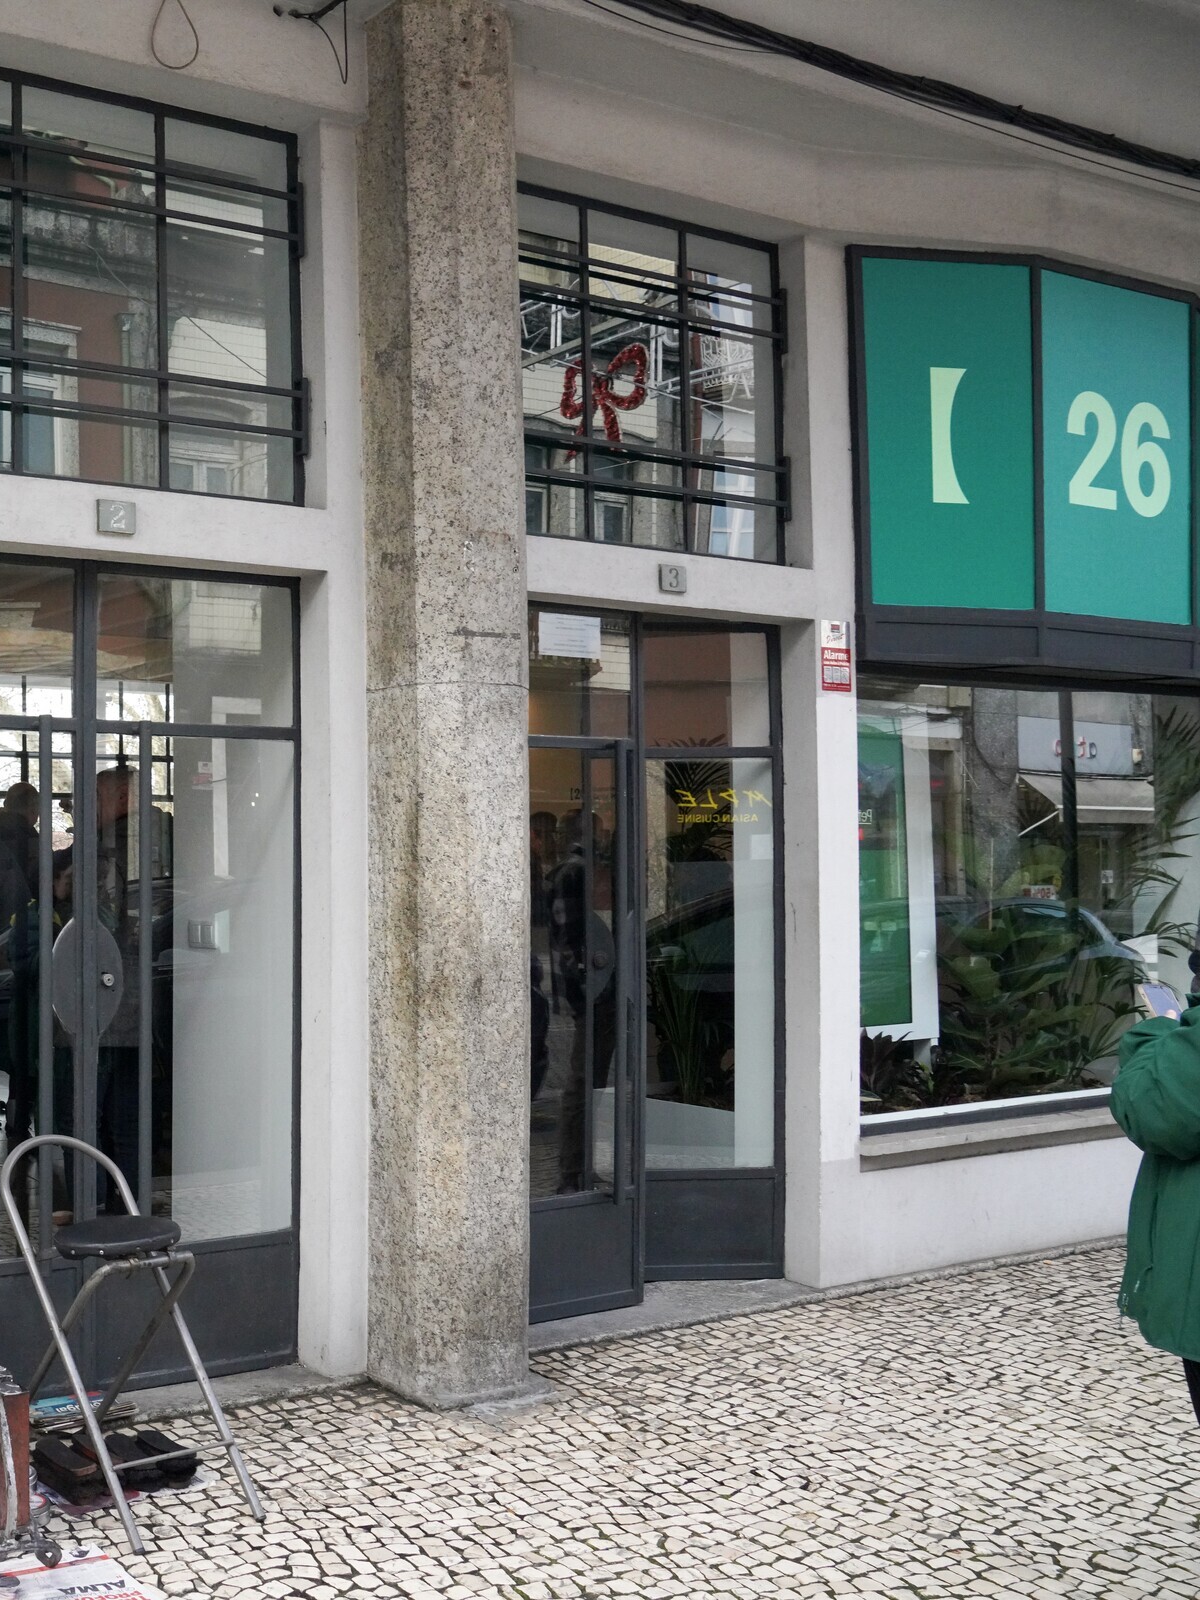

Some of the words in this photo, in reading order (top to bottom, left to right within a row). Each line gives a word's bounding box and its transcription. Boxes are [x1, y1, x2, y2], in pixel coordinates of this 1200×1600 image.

[109, 504, 126, 529] 2
[668, 567, 680, 589] 3
[823, 649, 849, 661] Alarme
[57, 1579, 126, 1595] ALMA
